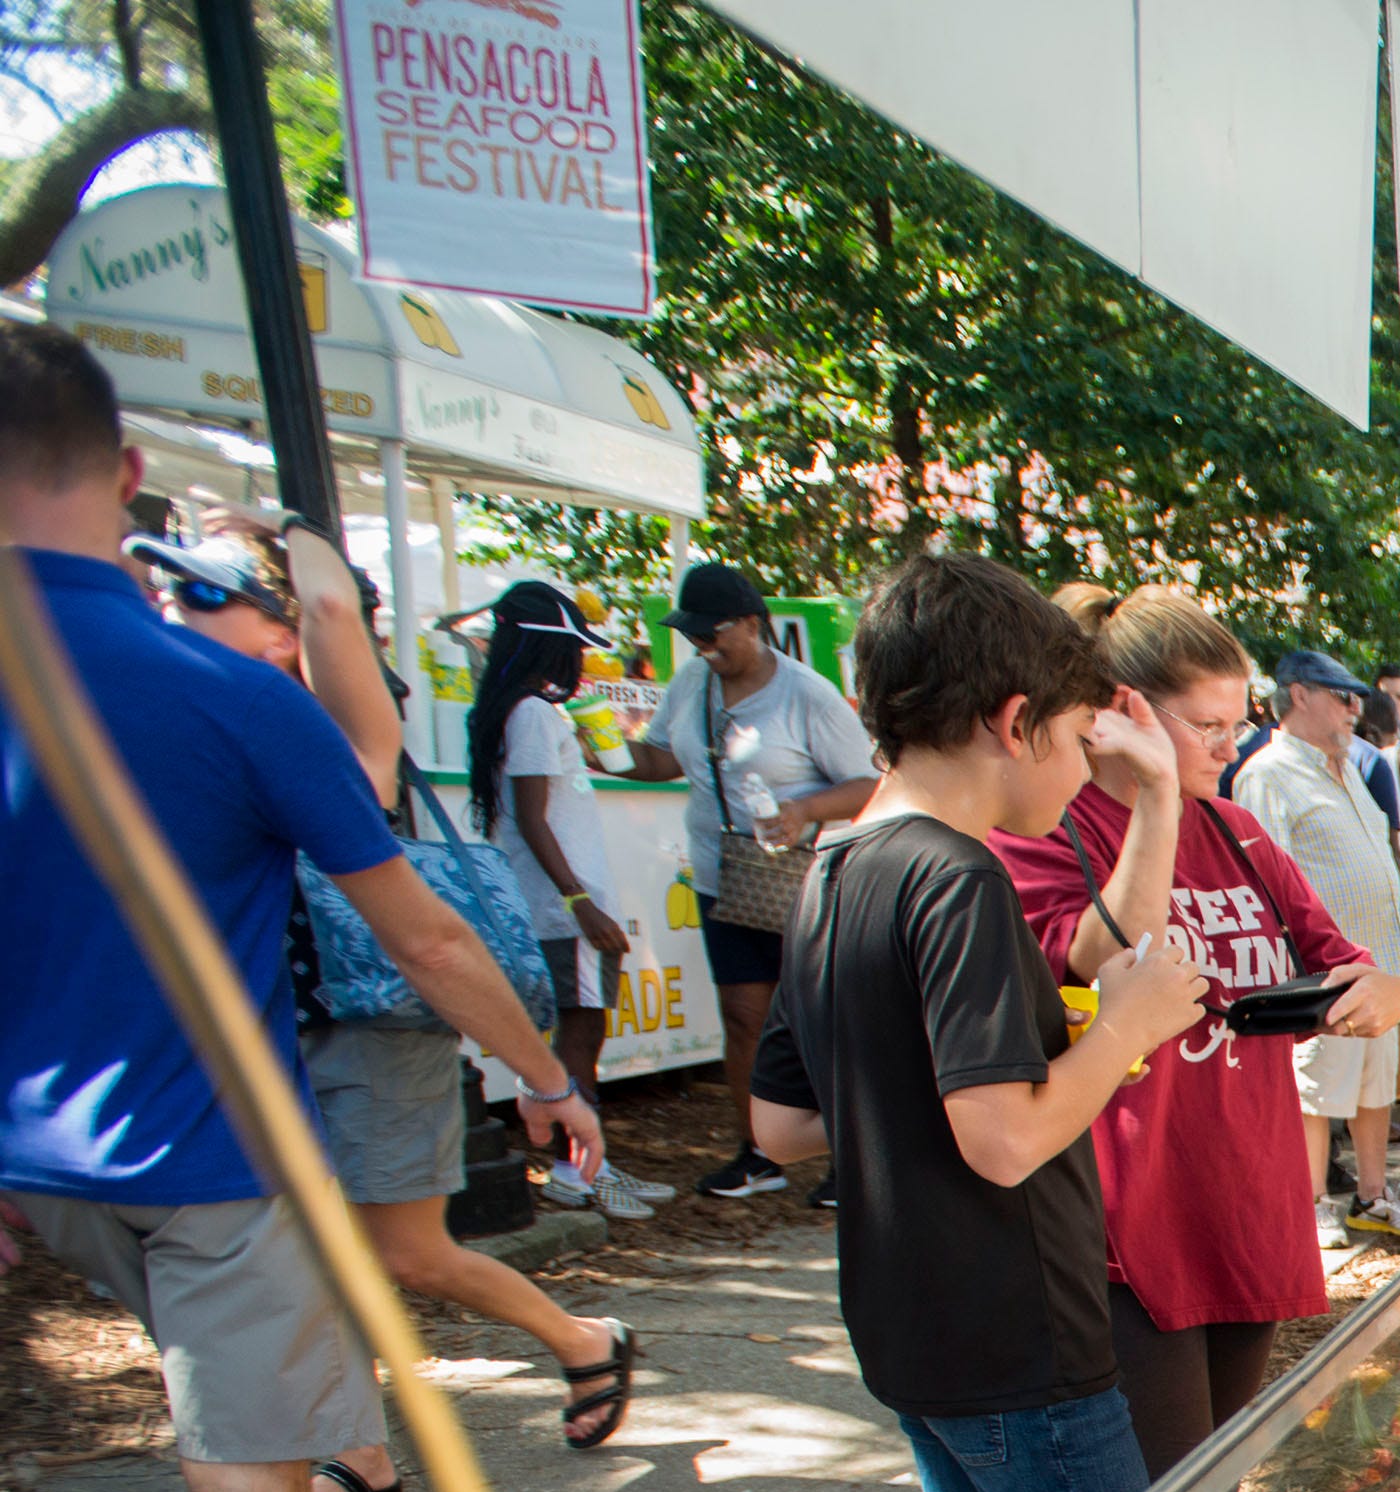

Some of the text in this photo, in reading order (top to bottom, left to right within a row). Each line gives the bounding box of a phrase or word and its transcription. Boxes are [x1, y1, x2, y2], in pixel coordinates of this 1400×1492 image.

[370, 22, 611, 117] PENSACOLA
[375, 89, 617, 155] SEAFOOD
[381, 127, 624, 212] FESTIVAL
[67, 198, 232, 302] Nanny's
[75, 321, 189, 363] FRESH
[596, 682, 640, 704] FRESH
[1168, 884, 1266, 937] EEP
